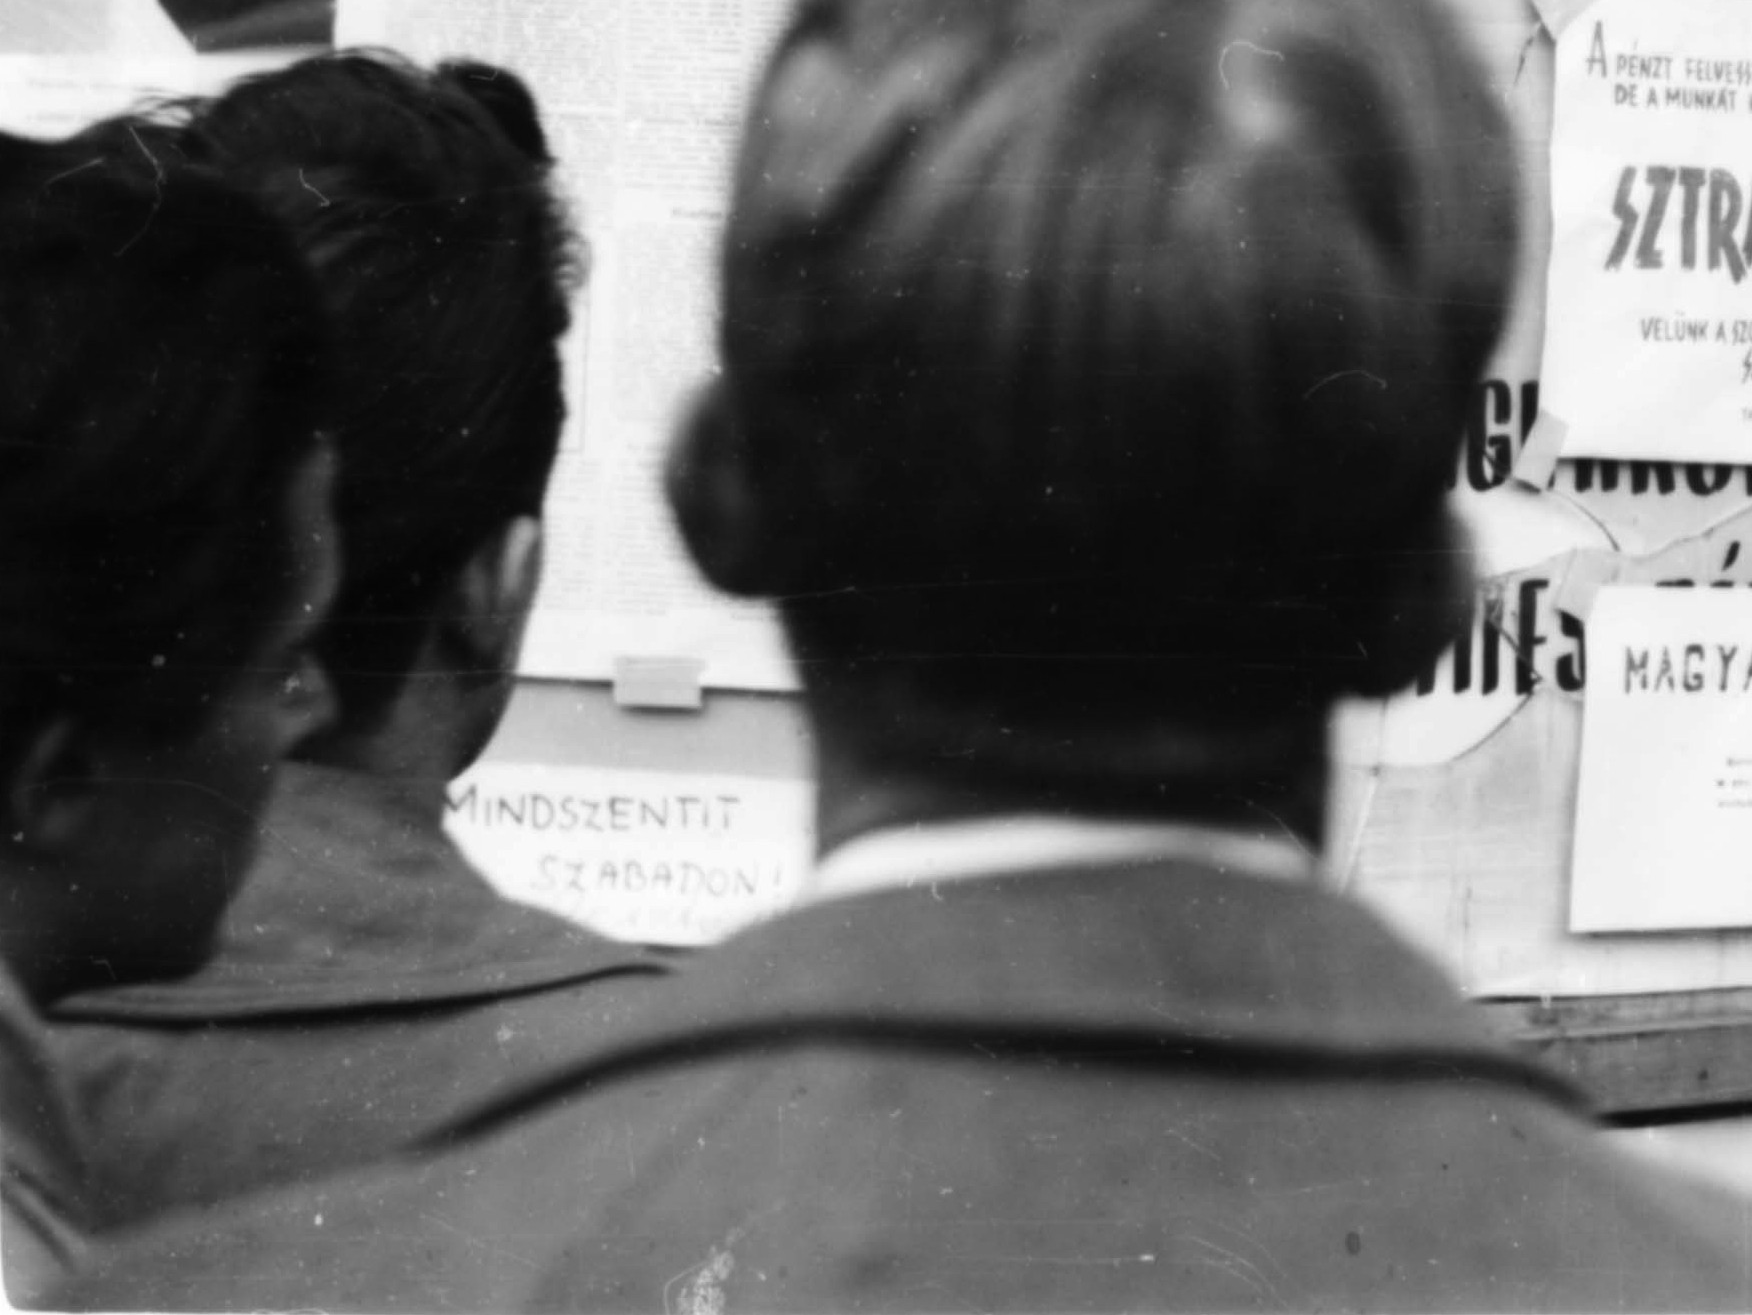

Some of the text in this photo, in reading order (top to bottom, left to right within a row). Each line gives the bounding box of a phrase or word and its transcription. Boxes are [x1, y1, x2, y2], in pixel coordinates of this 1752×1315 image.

[1585, 20, 1608, 78] A
[1615, 41, 1673, 82] PÉNZT
[1613, 83, 1639, 108] DE
[1645, 88, 1660, 110] A
[1715, 320, 1727, 343] A
[446, 782, 742, 832] MINDSZENTIT
